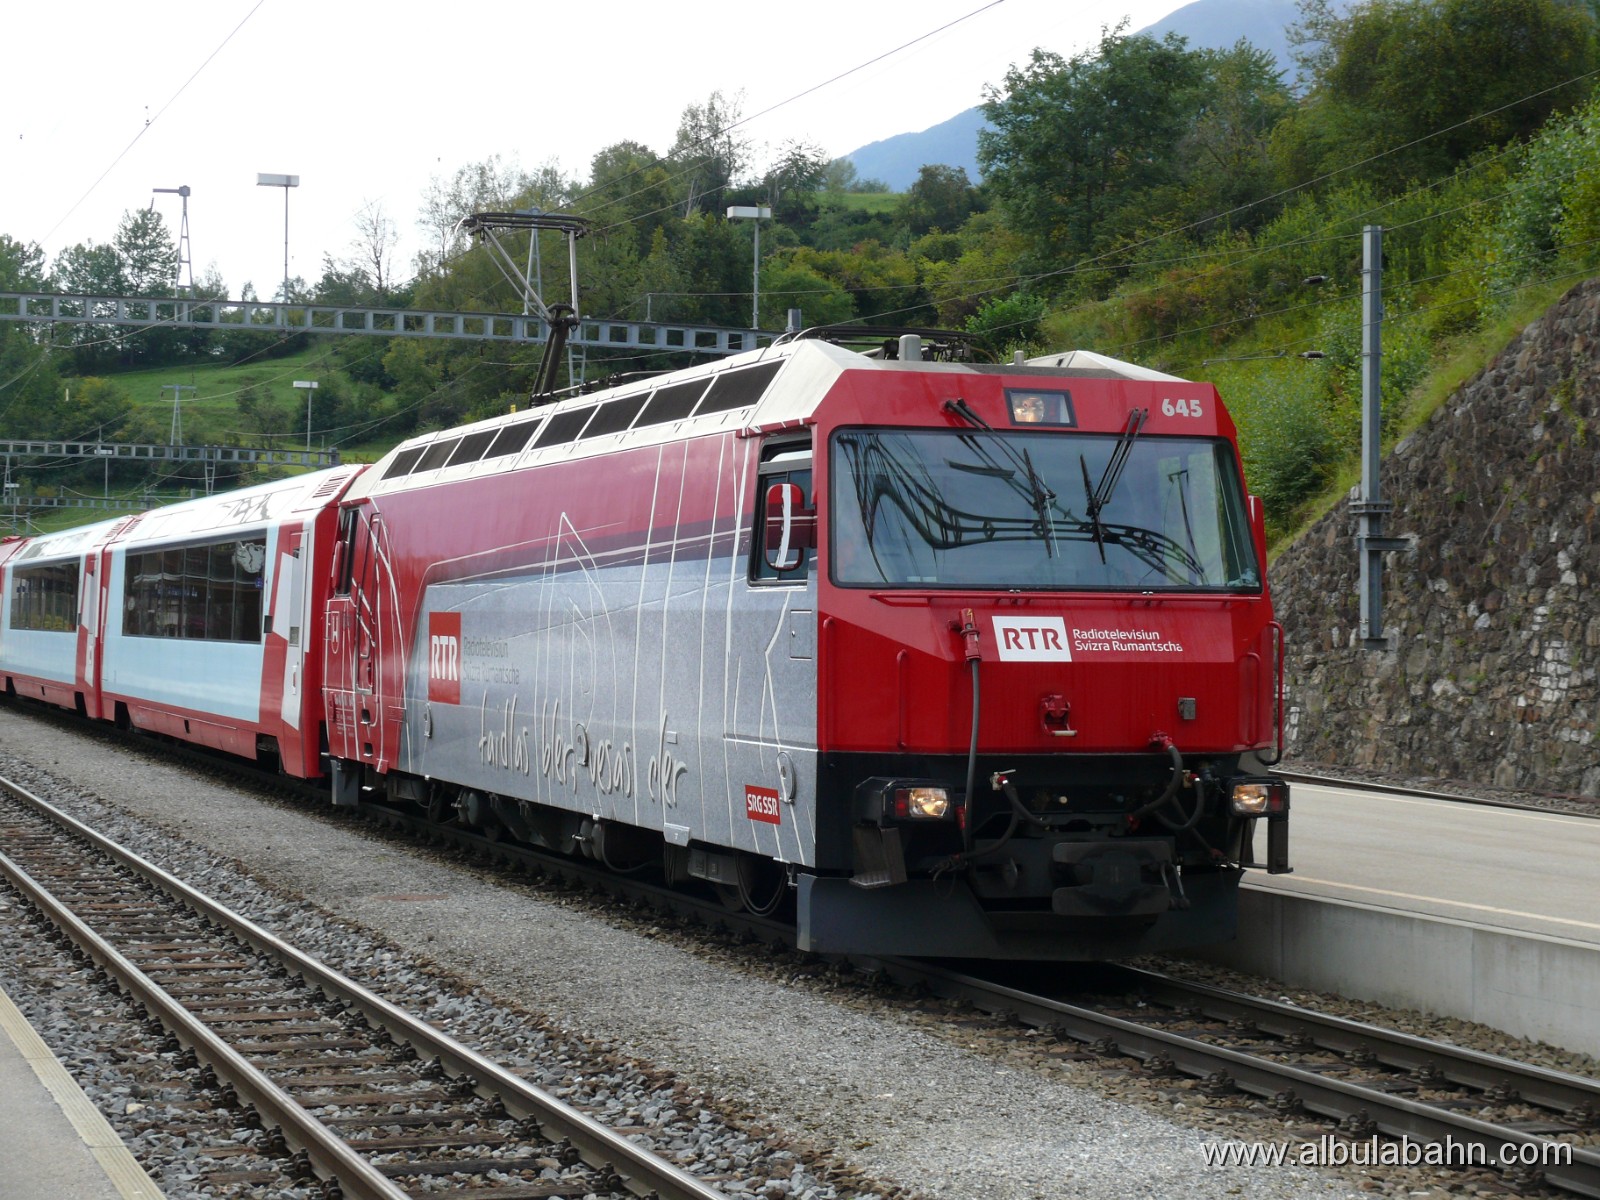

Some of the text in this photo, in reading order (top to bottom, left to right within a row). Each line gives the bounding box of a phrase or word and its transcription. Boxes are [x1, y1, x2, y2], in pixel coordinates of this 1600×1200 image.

[1161, 398, 1203, 418] 645
[1002, 628, 1063, 650] RTR
[1072, 628, 1160, 640] Radiotelevisiun
[1075, 640, 1183, 652] Svizra Rumantscha
[431, 634, 458, 682] RTR
[747, 793, 779, 816] SRG SSR
